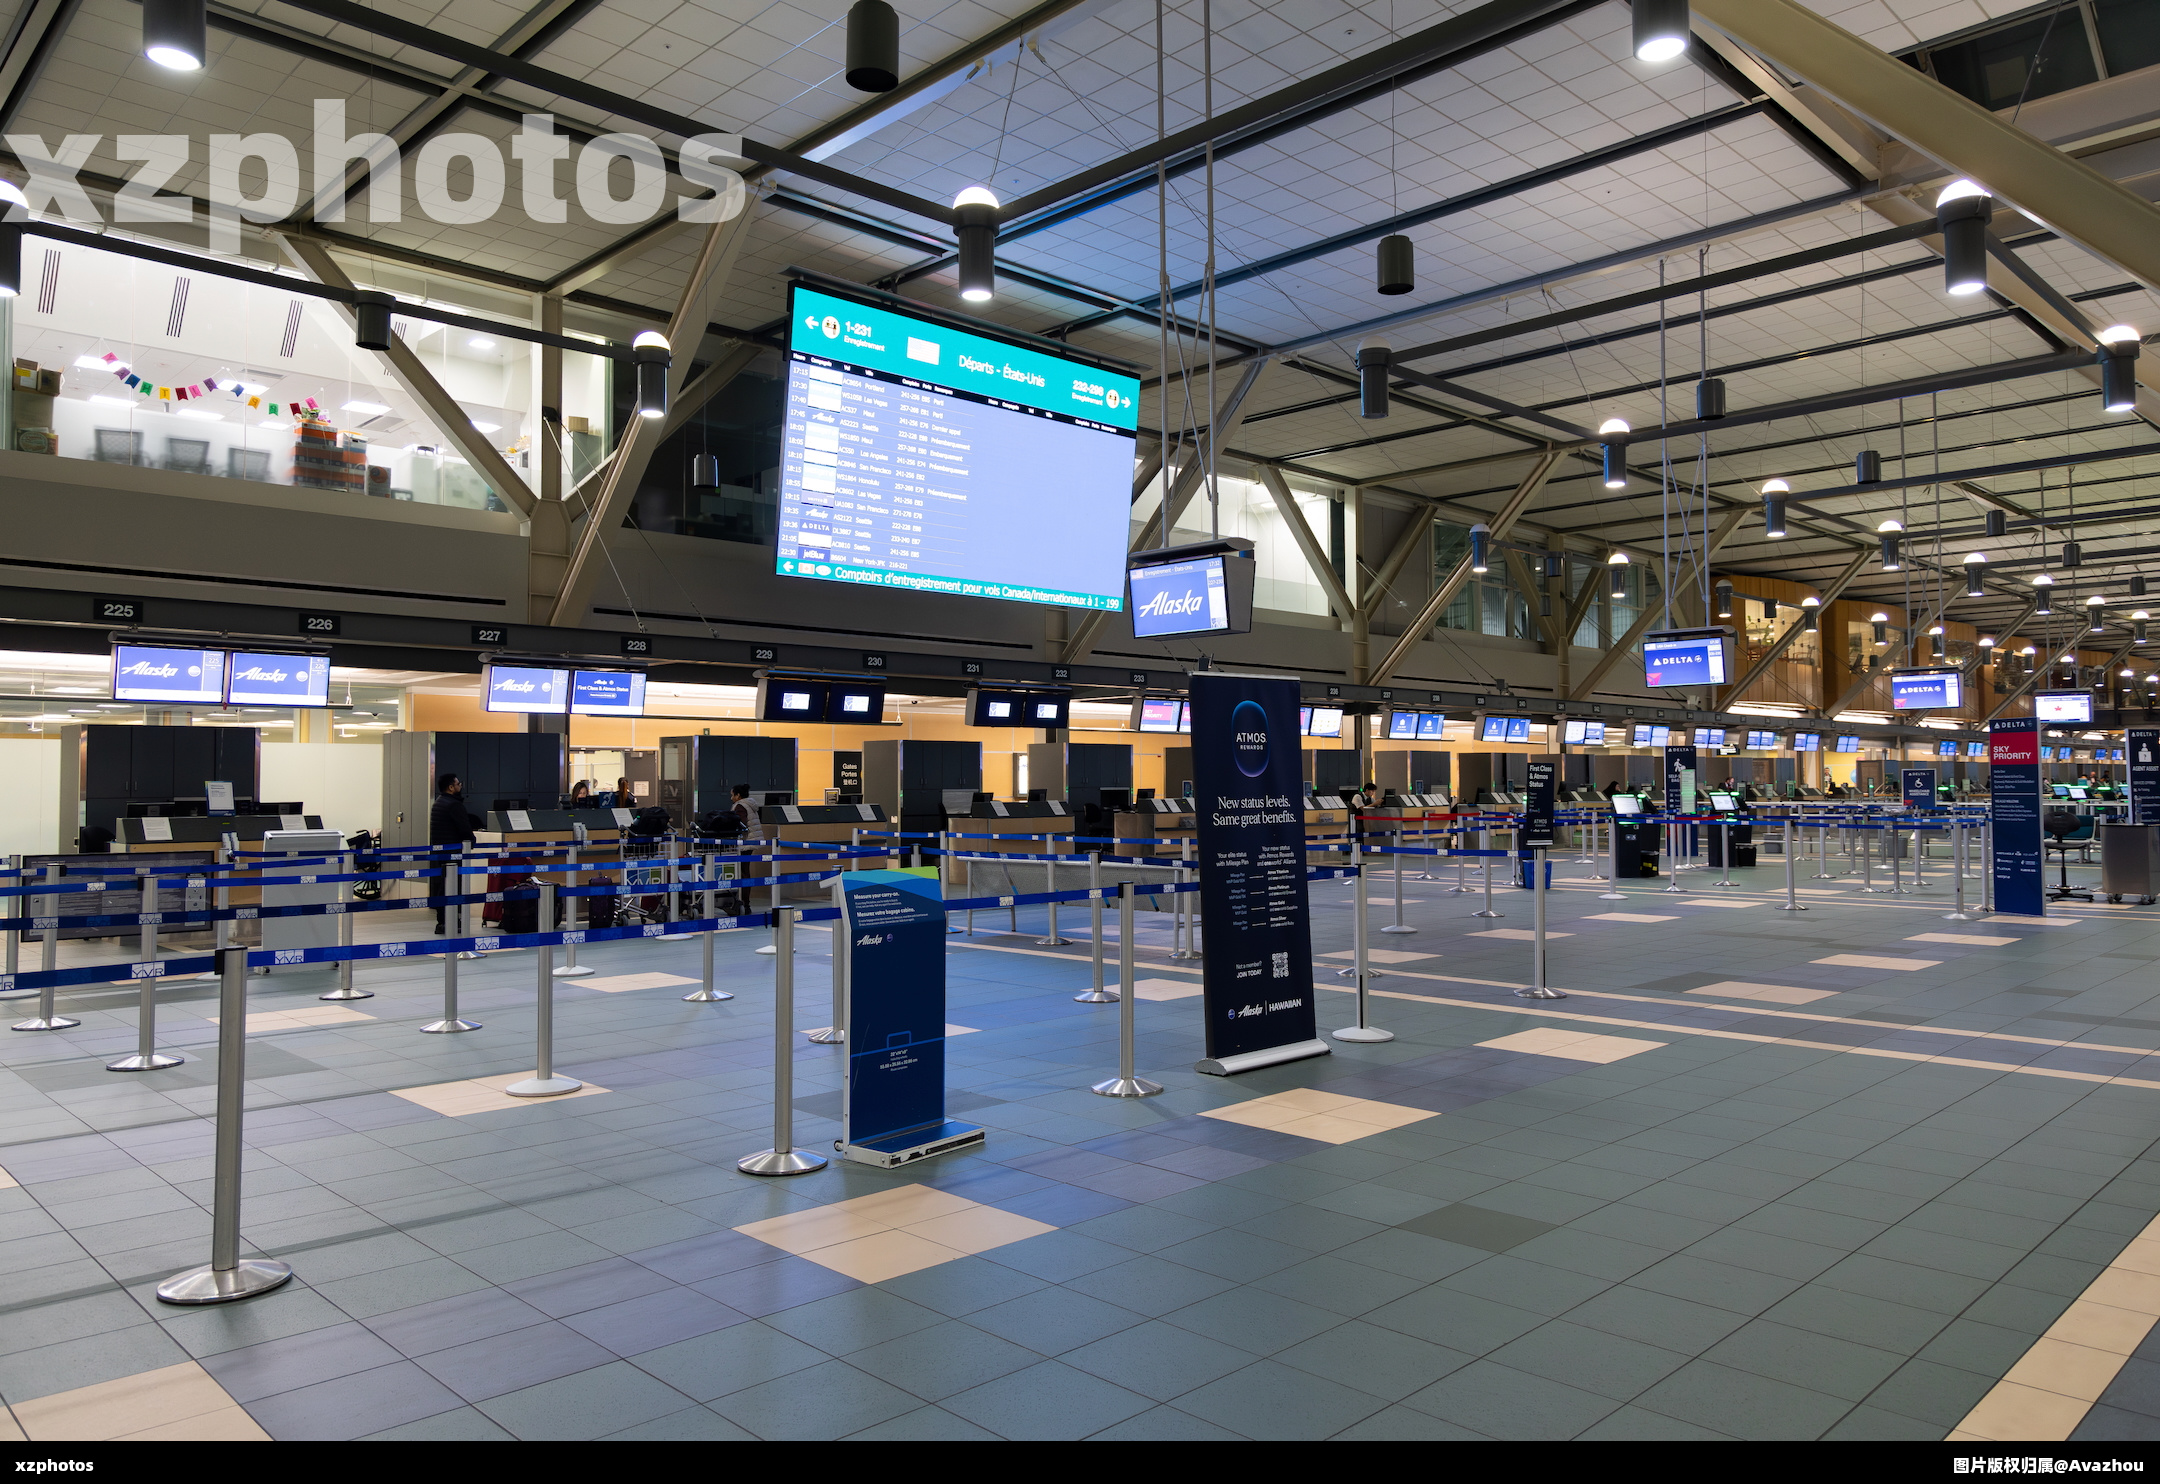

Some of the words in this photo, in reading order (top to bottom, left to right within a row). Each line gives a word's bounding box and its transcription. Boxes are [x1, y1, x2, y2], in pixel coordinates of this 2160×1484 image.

[846, 321, 871, 337] 1-231
[959, 354, 994, 375] Départs
[1004, 364, 1045, 387] États-Unis
[793, 366, 809, 376] 17:15
[865, 382, 885, 393] Portland
[792, 380, 808, 390] 17:30
[873, 398, 888, 408] Vegas
[792, 394, 807, 404] 17:40
[790, 422, 805, 432] 18:00
[791, 408, 806, 418] 17:45
[862, 423, 879, 432] Seattle
[789, 436, 804, 445] 18:05
[869, 452, 889, 462] Angeles
[788, 450, 803, 459] 18:10
[870, 465, 892, 475] Francisco
[787, 464, 802, 473] 18:15
[858, 477, 880, 486] Honolulu
[786, 478, 801, 487] 18:55
[866, 492, 882, 501] Vegas
[785, 492, 800, 501] 19:15
[867, 505, 889, 514] Francisco
[784, 506, 799, 514] 19:35
[856, 517, 873, 525] Seattle
[783, 520, 798, 528] 19:36
[854, 530, 872, 538] Seattle
[782, 534, 797, 542] 21:05
[854, 544, 871, 552] Seattle
[781, 548, 796, 556] 22:30
[804, 550, 824, 560] jetBlue
[835, 567, 882, 584] Comptoirs
[963, 584, 982, 594] pour
[984, 584, 1000, 596] vols
[1002, 586, 1086, 606] Canada/internationaux
[1095, 598, 1099, 606] 1
[1106, 598, 1119, 609] 199
[103, 603, 134, 618] 225
[1140, 590, 1203, 618] Alaska
[307, 617, 333, 631] 226
[478, 630, 501, 642] 227
[627, 640, 647, 652] 228
[756, 649, 774, 660] 229
[867, 656, 883, 667] 230
[1663, 656, 1692, 664] DELTA
[121, 661, 178, 678] Alaska
[235, 666, 288, 683] Alaska
[966, 663, 980, 673] 231
[1055, 669, 1068, 678] 232
[494, 678, 536, 694] Alaska
[1133, 674, 1145, 683] 233
[1236, 733, 1266, 743] ATMOS
[1218, 796, 1240, 810] New
[1241, 798, 1265, 809] status
[1266, 794, 1291, 808] levels.
[1212, 812, 1240, 826] Same
[1241, 813, 1261, 828] great
[1262, 810, 1297, 824] benefits.
[857, 934, 883, 946] Alaska
[1238, 1004, 1263, 1018] Alaska
[1269, 999, 1302, 1012] HAWAIIAN
